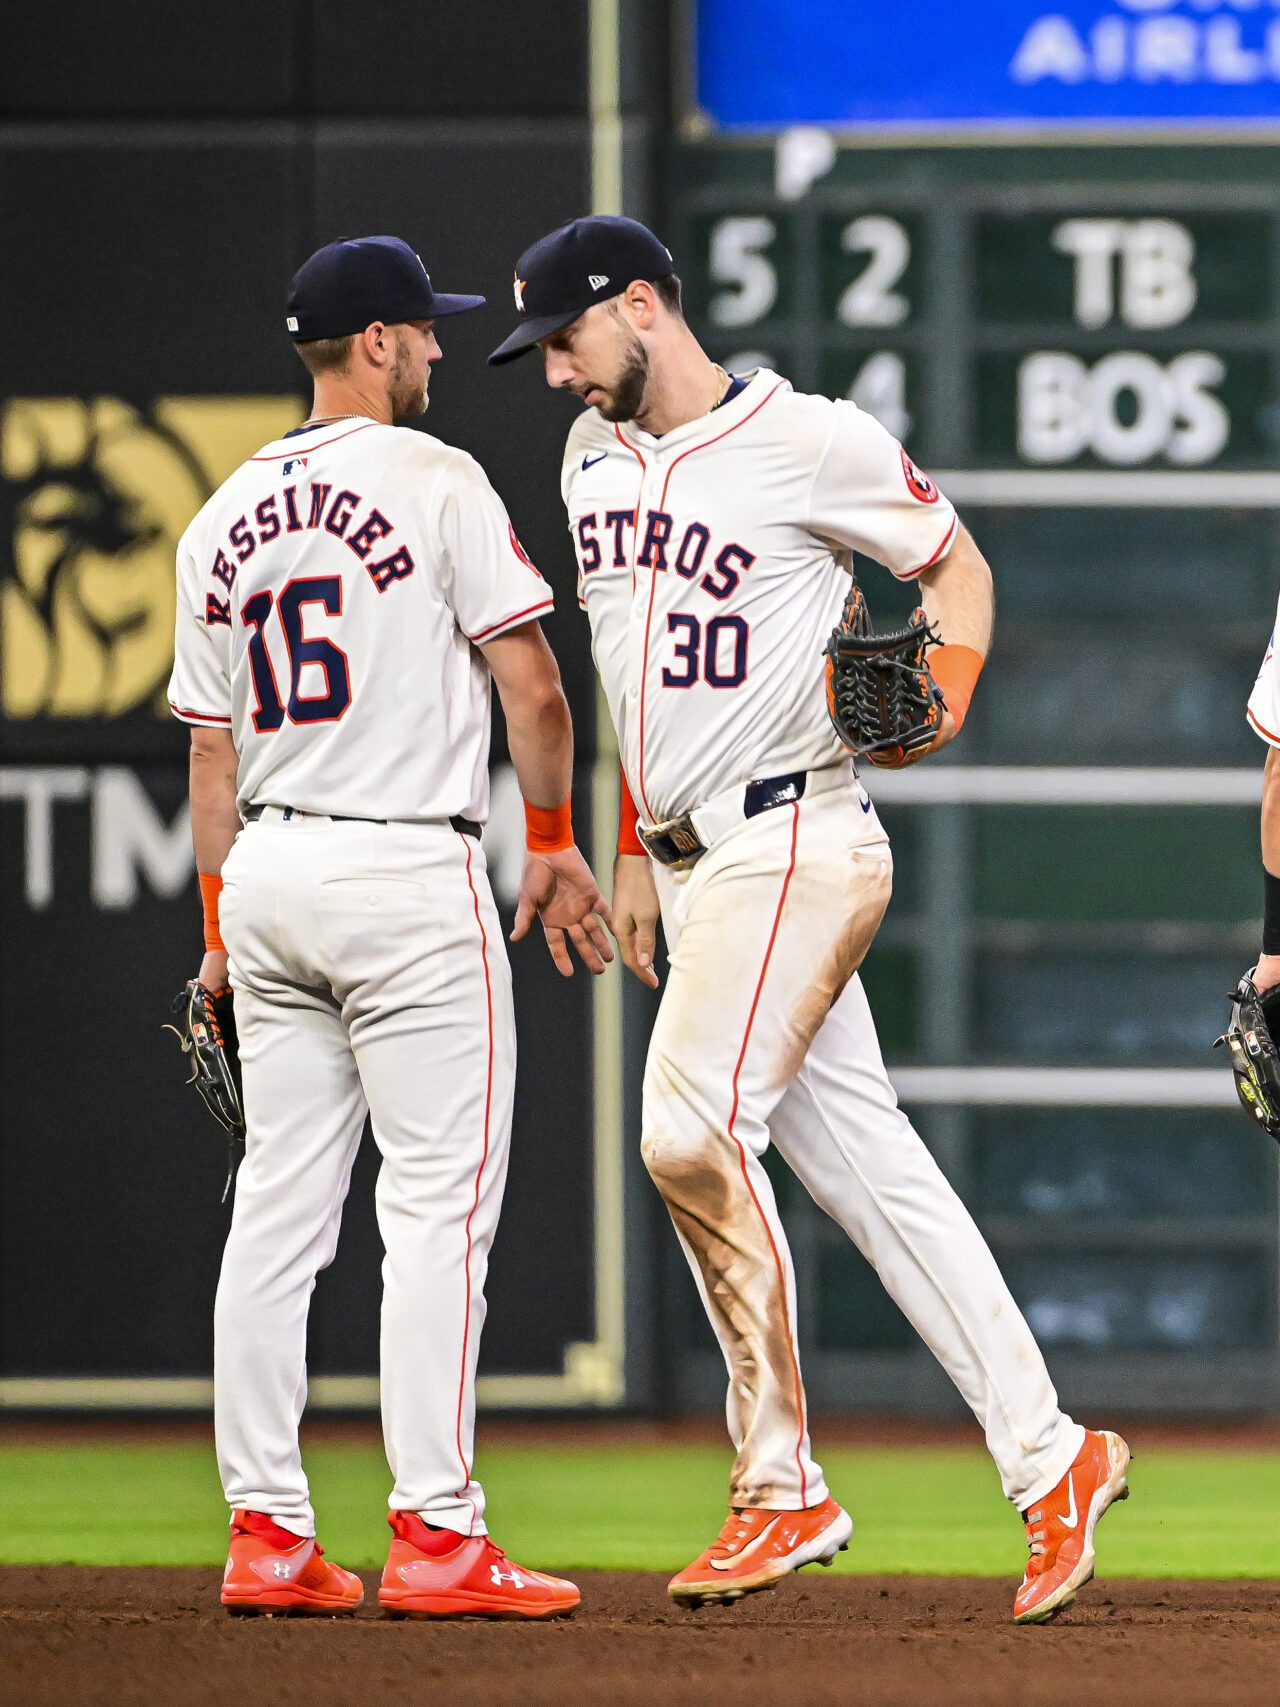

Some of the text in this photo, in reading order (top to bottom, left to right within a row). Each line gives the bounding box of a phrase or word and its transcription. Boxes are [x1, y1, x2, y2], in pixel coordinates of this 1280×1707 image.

[775, 129, 835, 200] P
[710, 215, 1197, 330] 5 2 TB
[1016, 351, 1230, 466] BOS
[206, 482, 416, 627] KESSINGER
[578, 508, 757, 601] STROS
[240, 574, 353, 734] 16
[661, 611, 751, 690] 30
